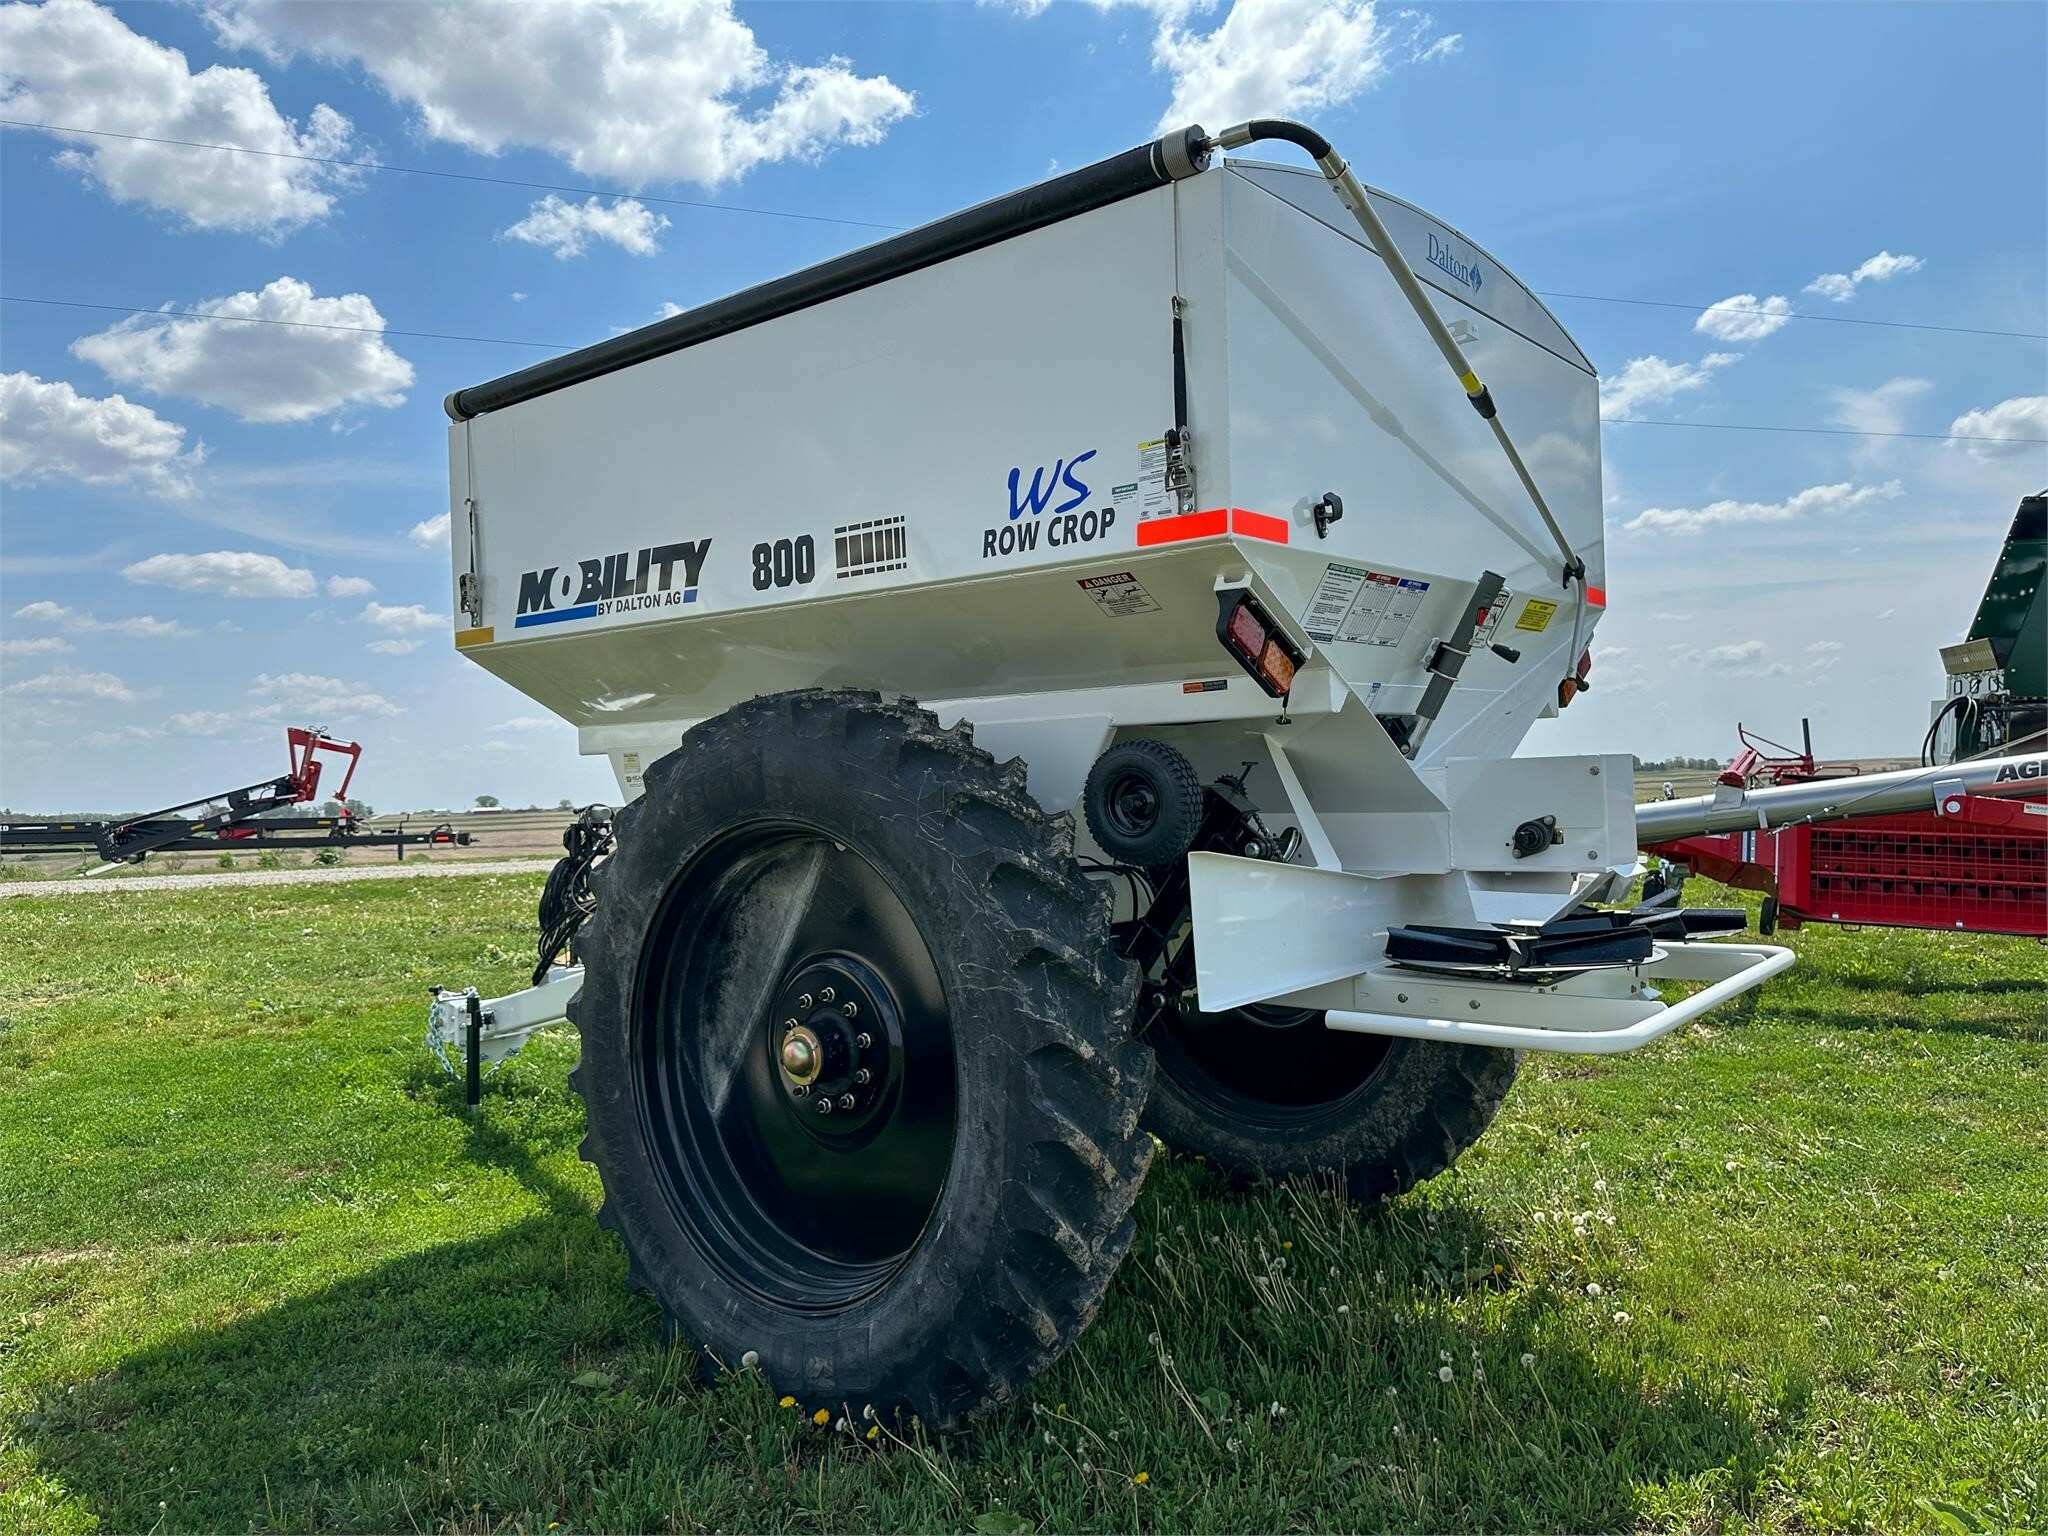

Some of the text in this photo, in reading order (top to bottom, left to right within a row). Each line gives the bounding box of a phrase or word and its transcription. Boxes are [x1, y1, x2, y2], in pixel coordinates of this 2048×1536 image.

[1427, 232, 1469, 282] Dalton
[1007, 449, 1097, 520] WS
[982, 507, 1116, 558] ROW CROP
[516, 538, 713, 615] MOBILITY
[752, 534, 816, 591] 800
[1092, 573, 1132, 588] DANGER
[598, 591, 681, 616] BY DALTON AG
